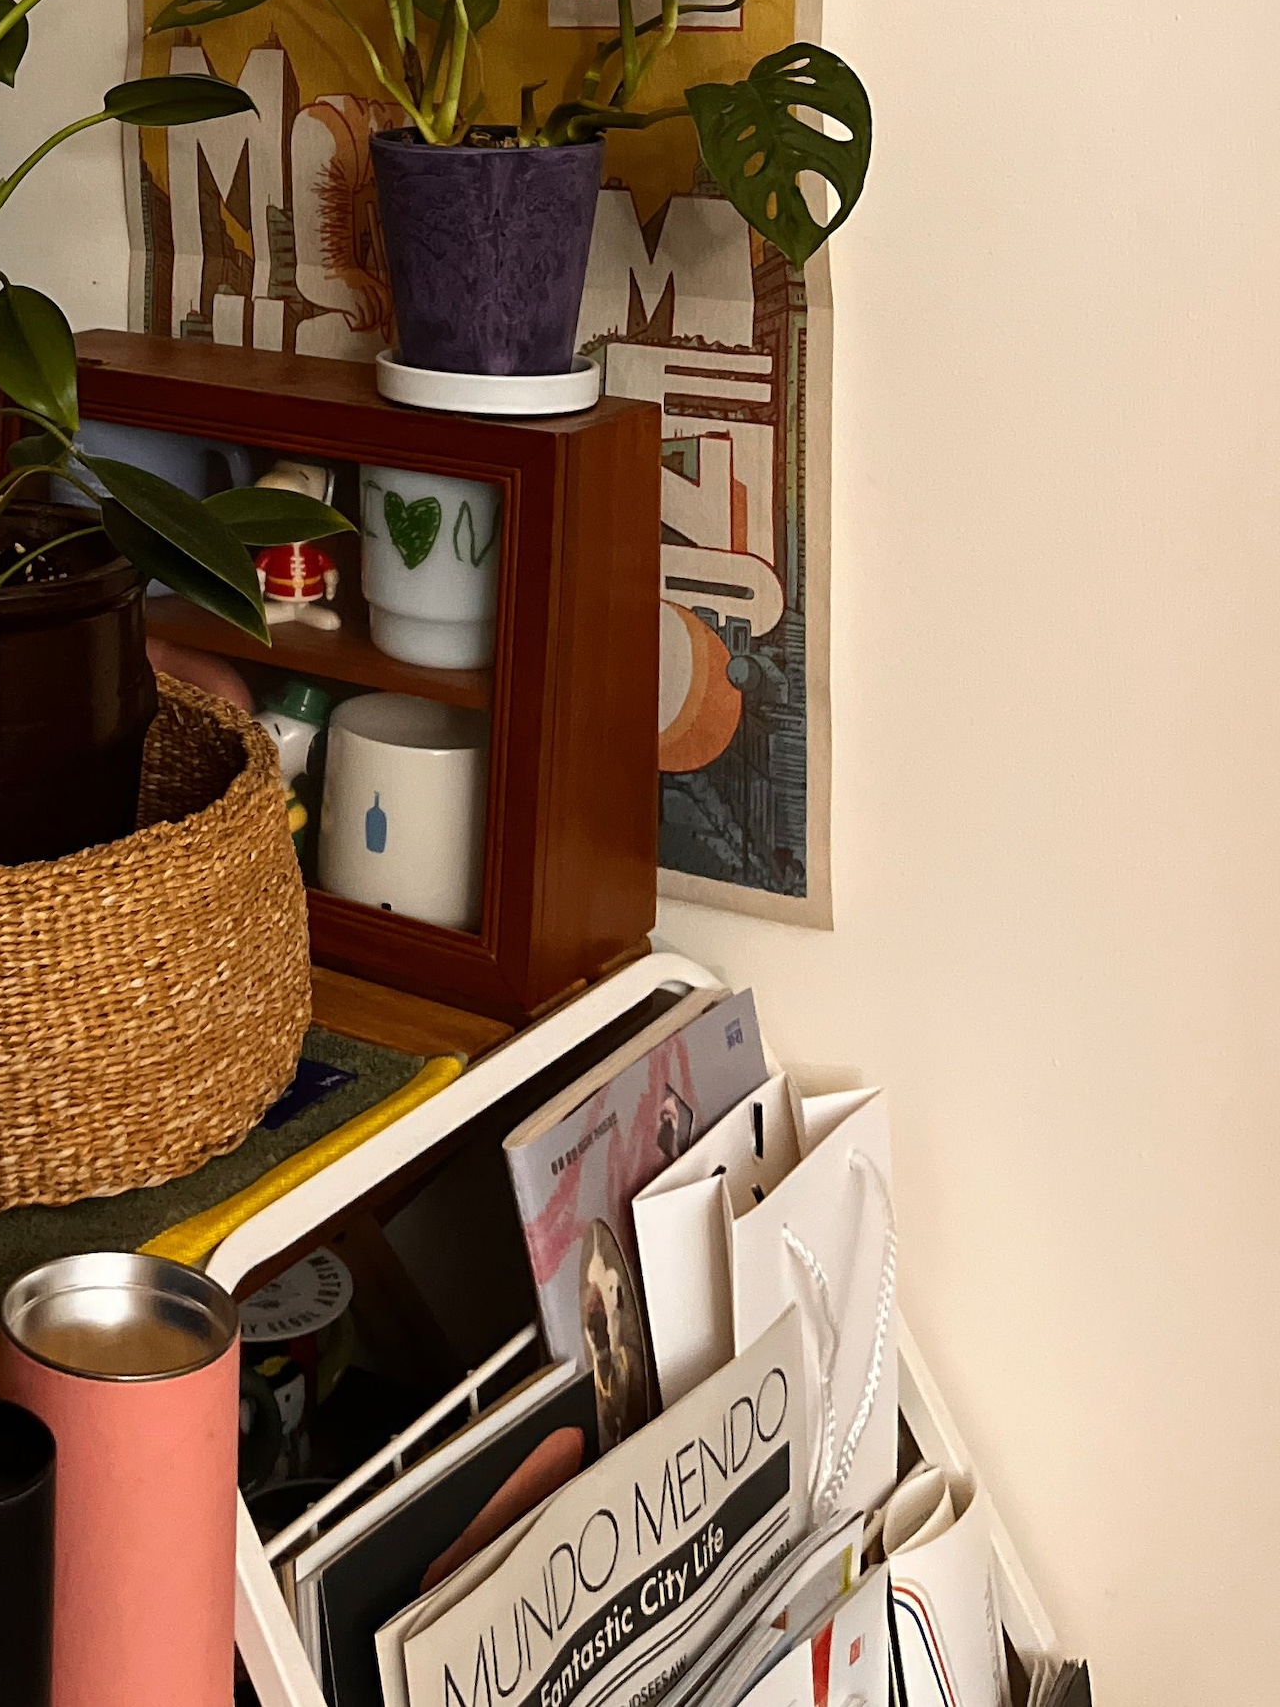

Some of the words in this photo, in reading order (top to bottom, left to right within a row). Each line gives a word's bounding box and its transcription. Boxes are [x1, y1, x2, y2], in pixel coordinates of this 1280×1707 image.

[444, 1508, 619, 1707] MUNDO
[634, 1366, 789, 1558] MENDO
[540, 1603, 634, 1707] Fantastic
[639, 1562, 689, 1617] City
[692, 1523, 724, 1578] Life
